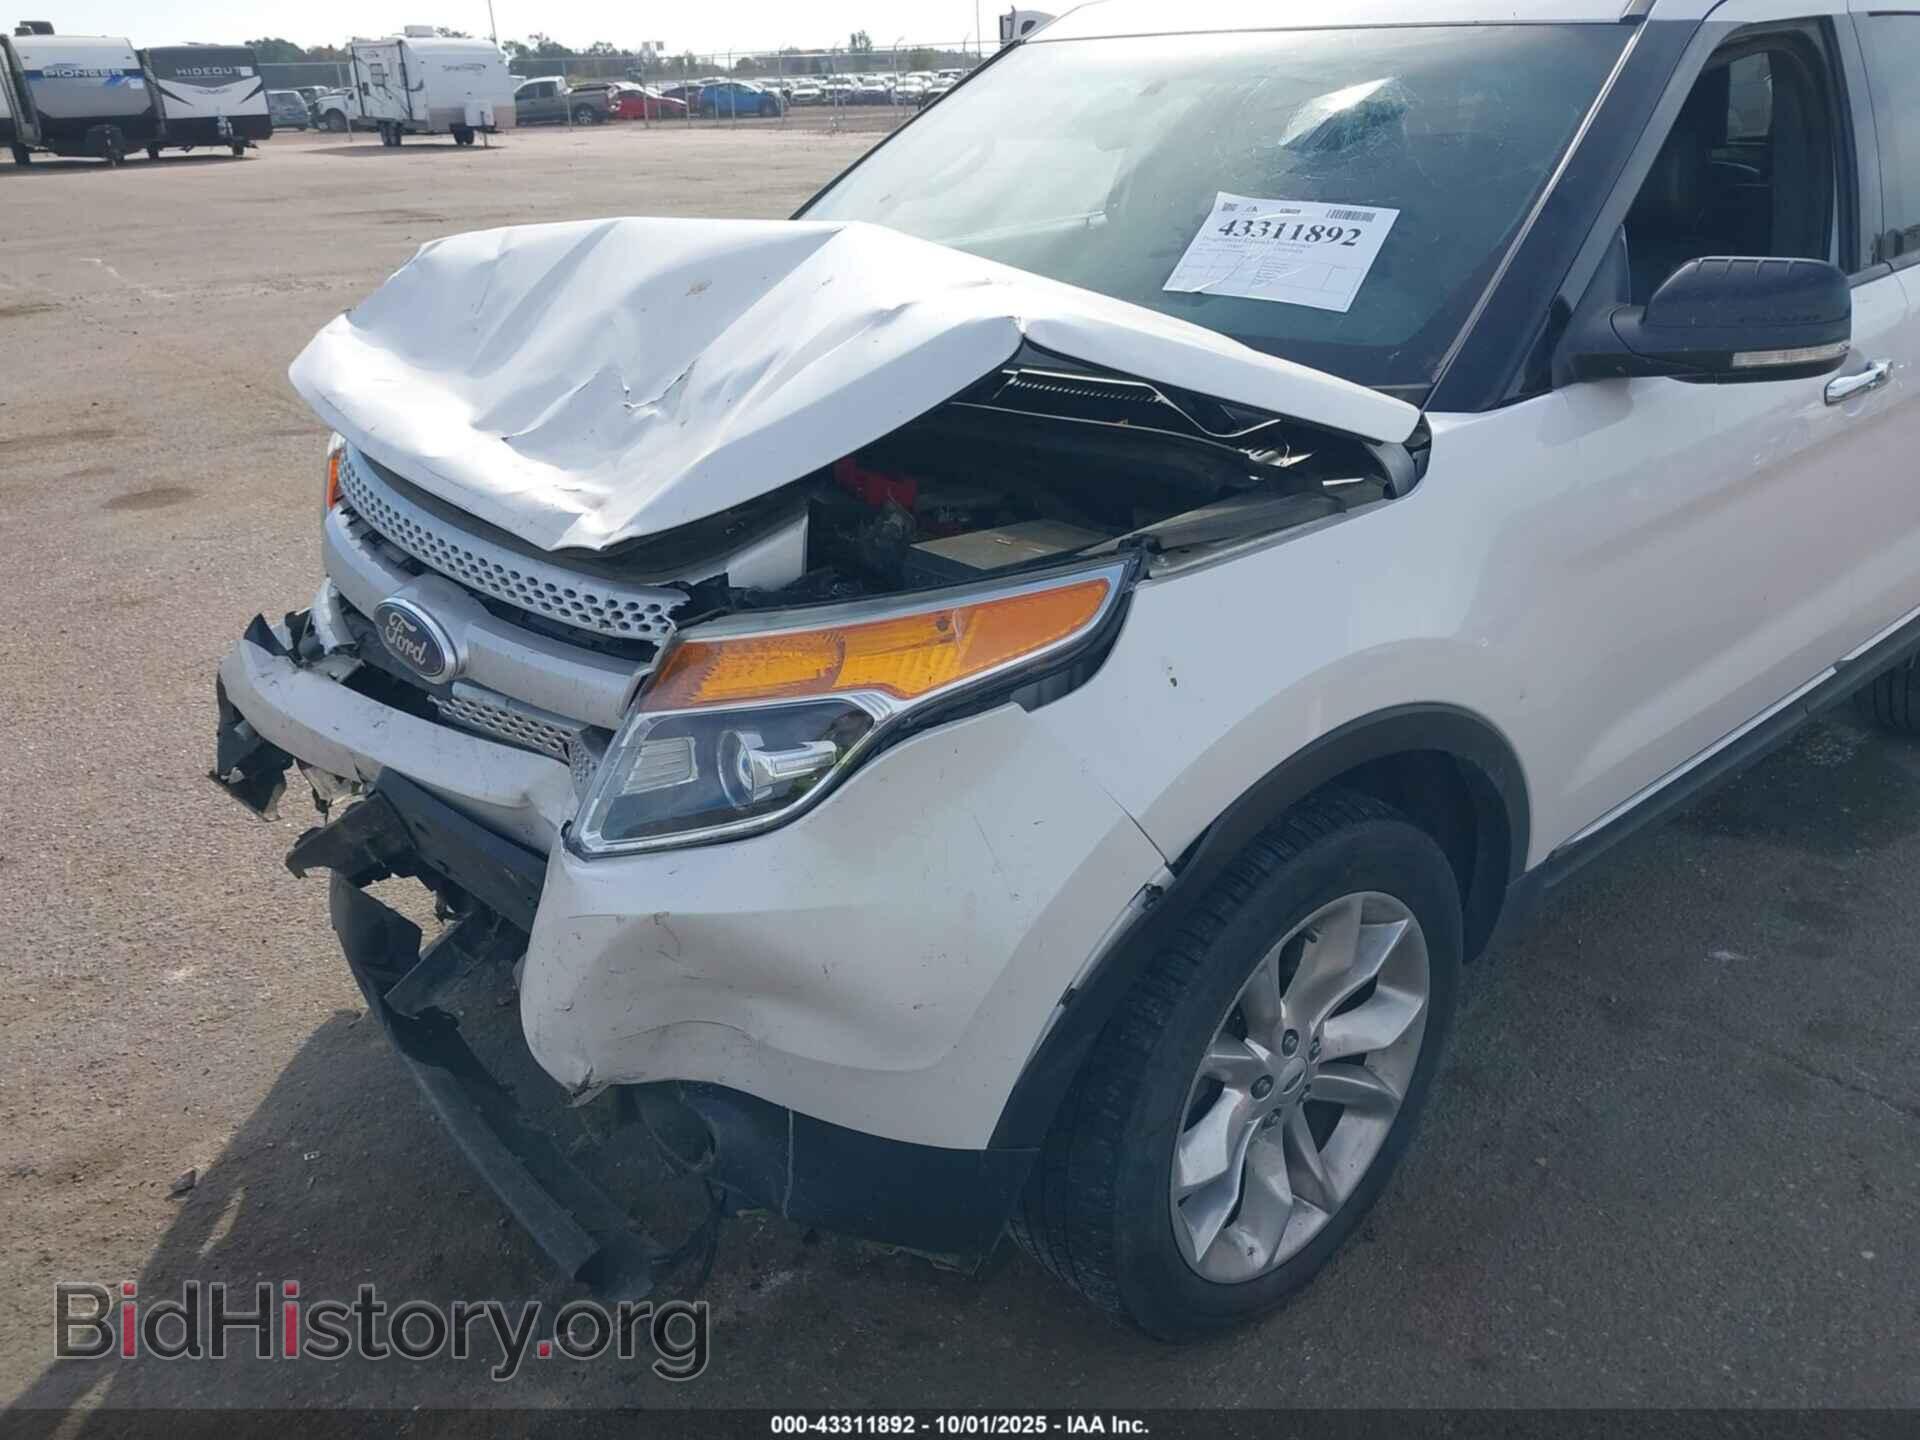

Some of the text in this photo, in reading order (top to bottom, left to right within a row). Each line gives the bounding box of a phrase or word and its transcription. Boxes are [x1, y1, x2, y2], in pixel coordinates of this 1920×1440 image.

[42, 68, 124, 78] PIONEER
[1218, 219, 1362, 247] 43311892
[385, 612, 427, 665] Ford
